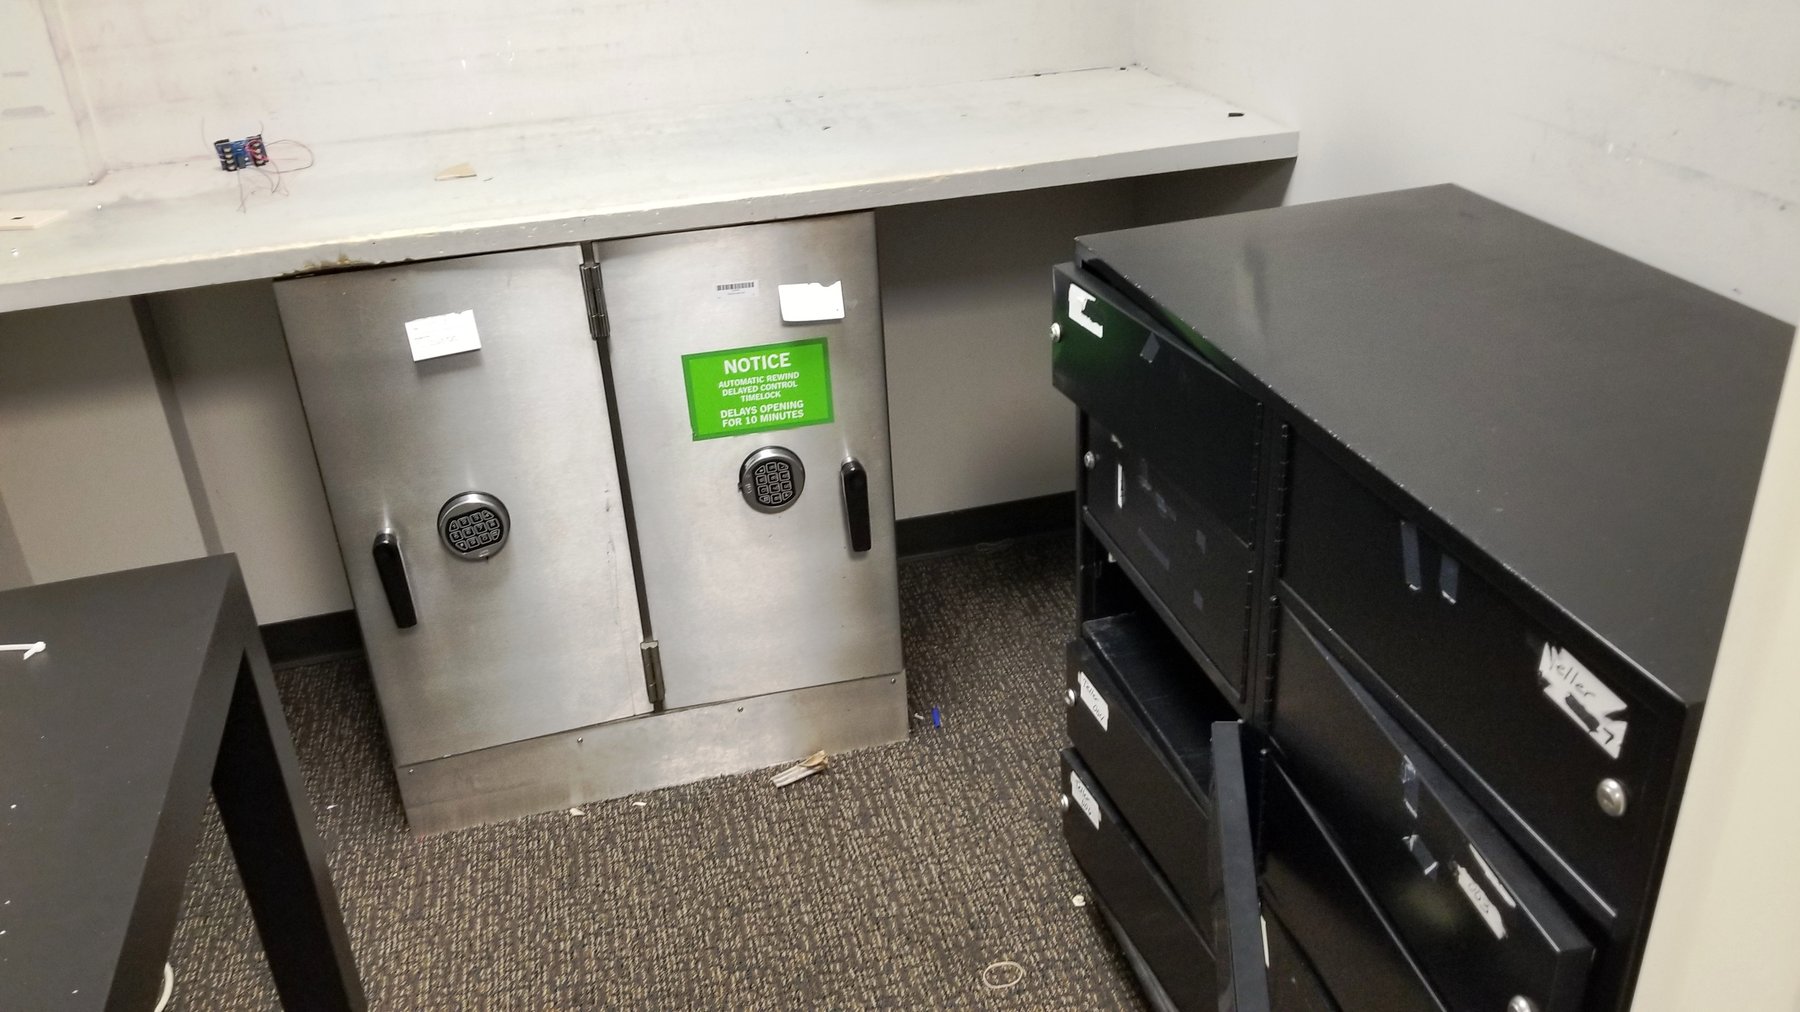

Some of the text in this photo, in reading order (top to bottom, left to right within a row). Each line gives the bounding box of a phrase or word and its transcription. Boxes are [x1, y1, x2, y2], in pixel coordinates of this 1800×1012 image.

[724, 352, 791, 375] NOTICE
[718, 371, 800, 389] AUTOMATIC REWIND
[722, 381, 798, 397] DELAYED CONTROL
[740, 391, 782, 403] TIMELOCK
[720, 400, 804, 419] DELAYS OPENING
[722, 409, 804, 428] FOR 10 MINUTES
